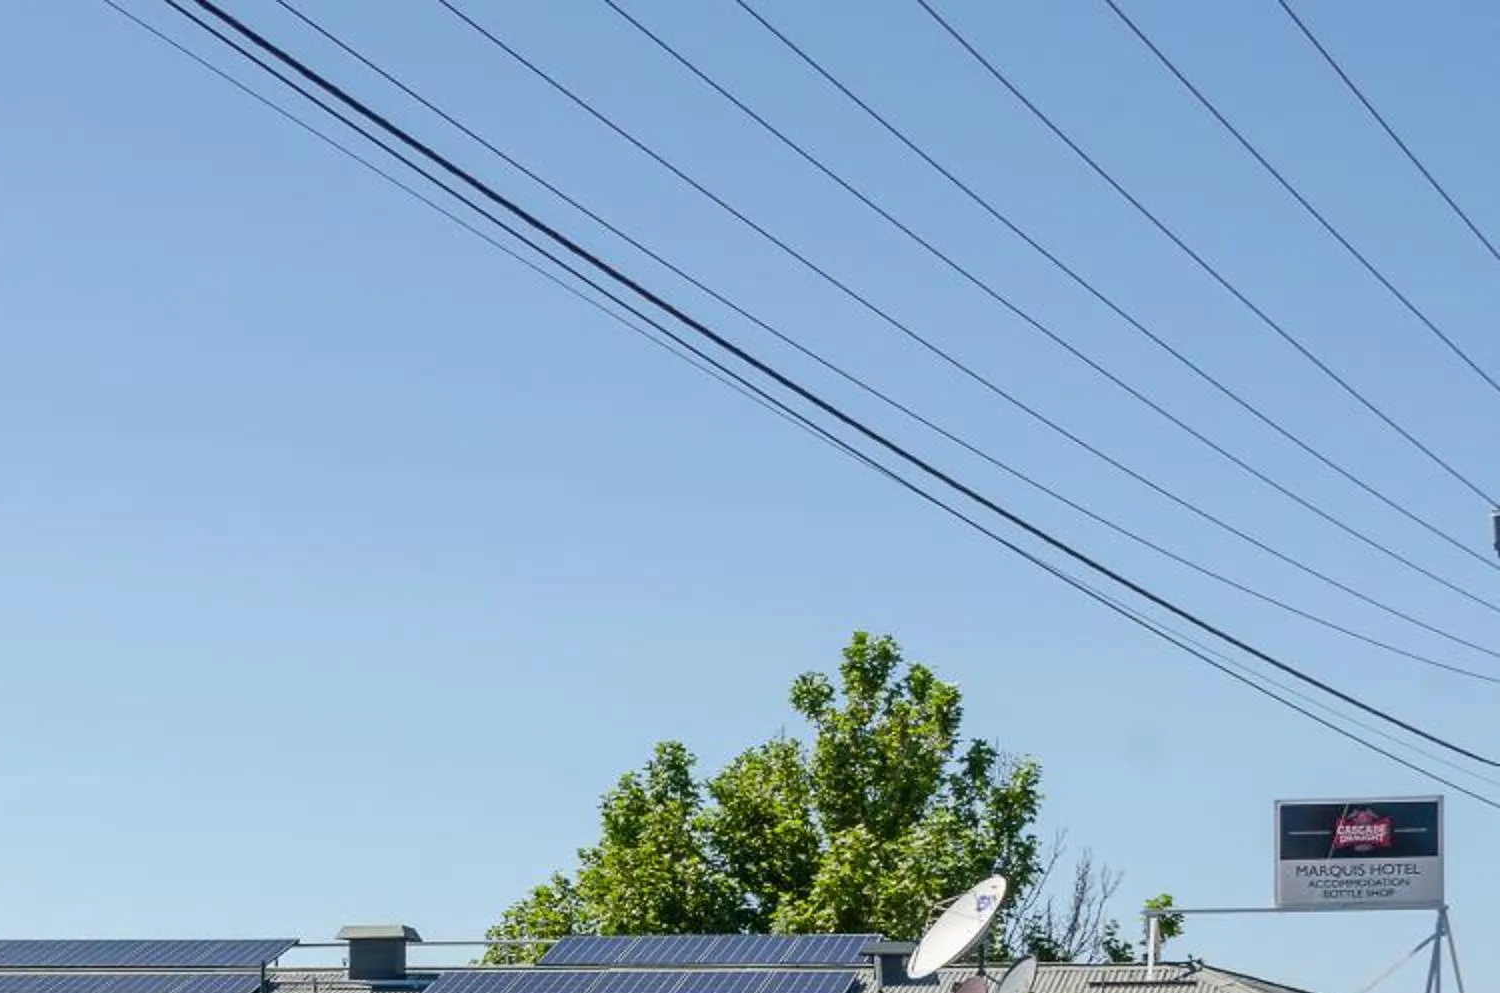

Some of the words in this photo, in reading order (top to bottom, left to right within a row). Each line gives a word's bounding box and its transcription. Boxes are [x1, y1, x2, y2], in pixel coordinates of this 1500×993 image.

[1295, 863, 1365, 877] MARQUIS
[1369, 863, 1421, 876] HOTEL
[1308, 877, 1411, 889] ACCOMMODATION
[1323, 888, 1363, 899] BOTTLE
[1366, 888, 1395, 898] SHOP
